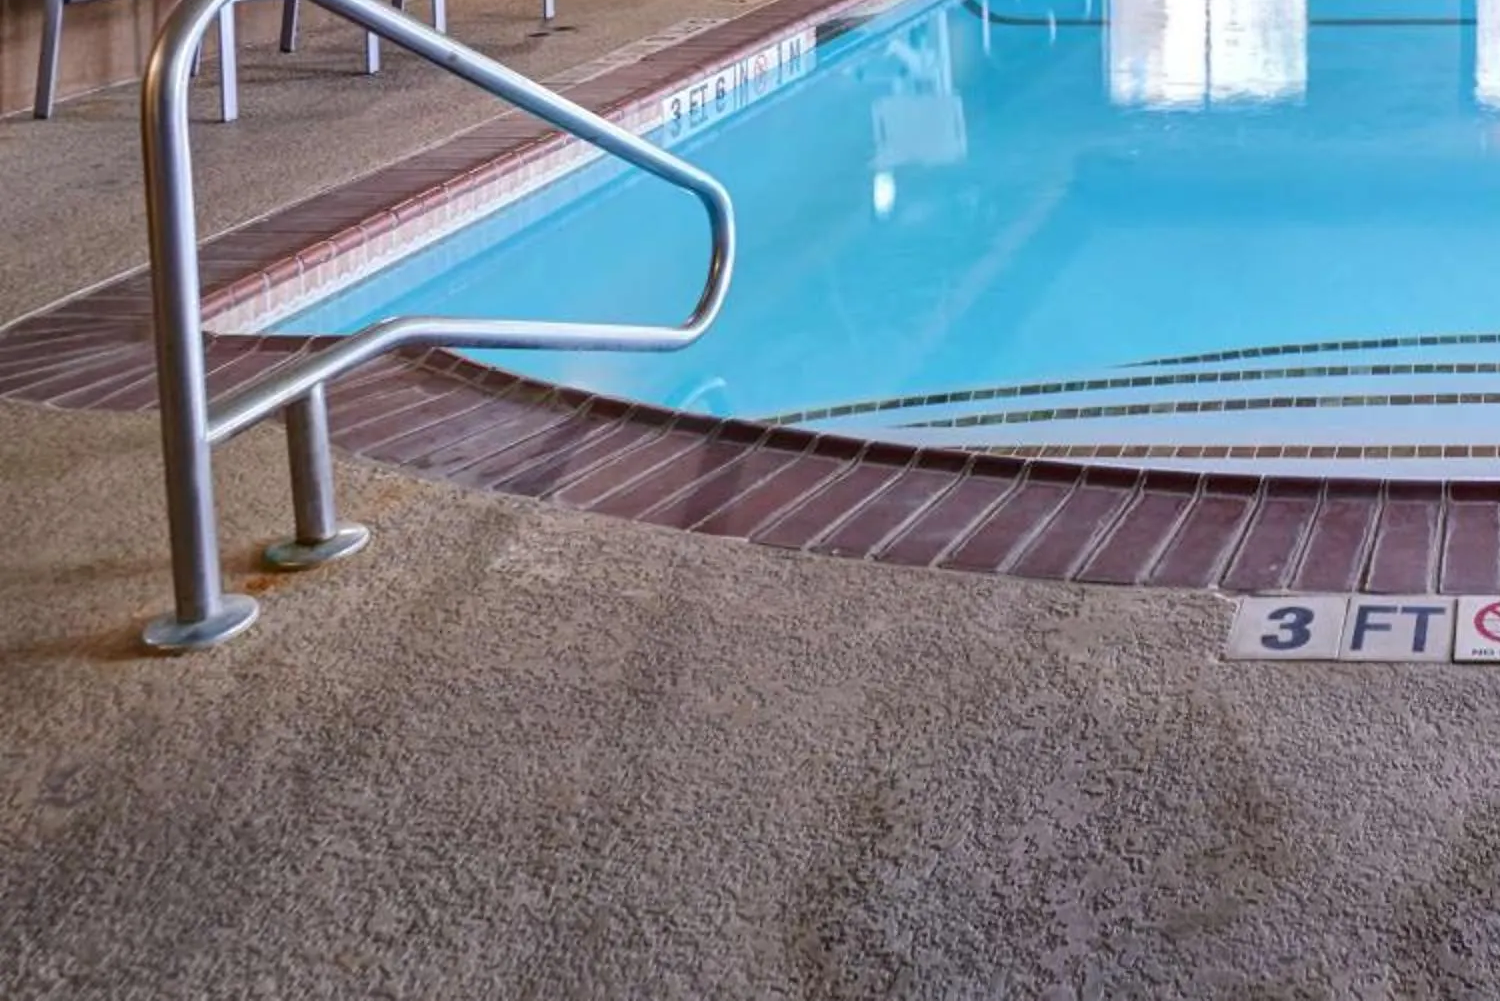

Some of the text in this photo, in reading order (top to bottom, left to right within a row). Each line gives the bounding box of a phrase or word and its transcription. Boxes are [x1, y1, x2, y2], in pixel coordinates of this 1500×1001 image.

[1260, 605, 1446, 653] 3 FT
[1471, 648, 1495, 657] NO
